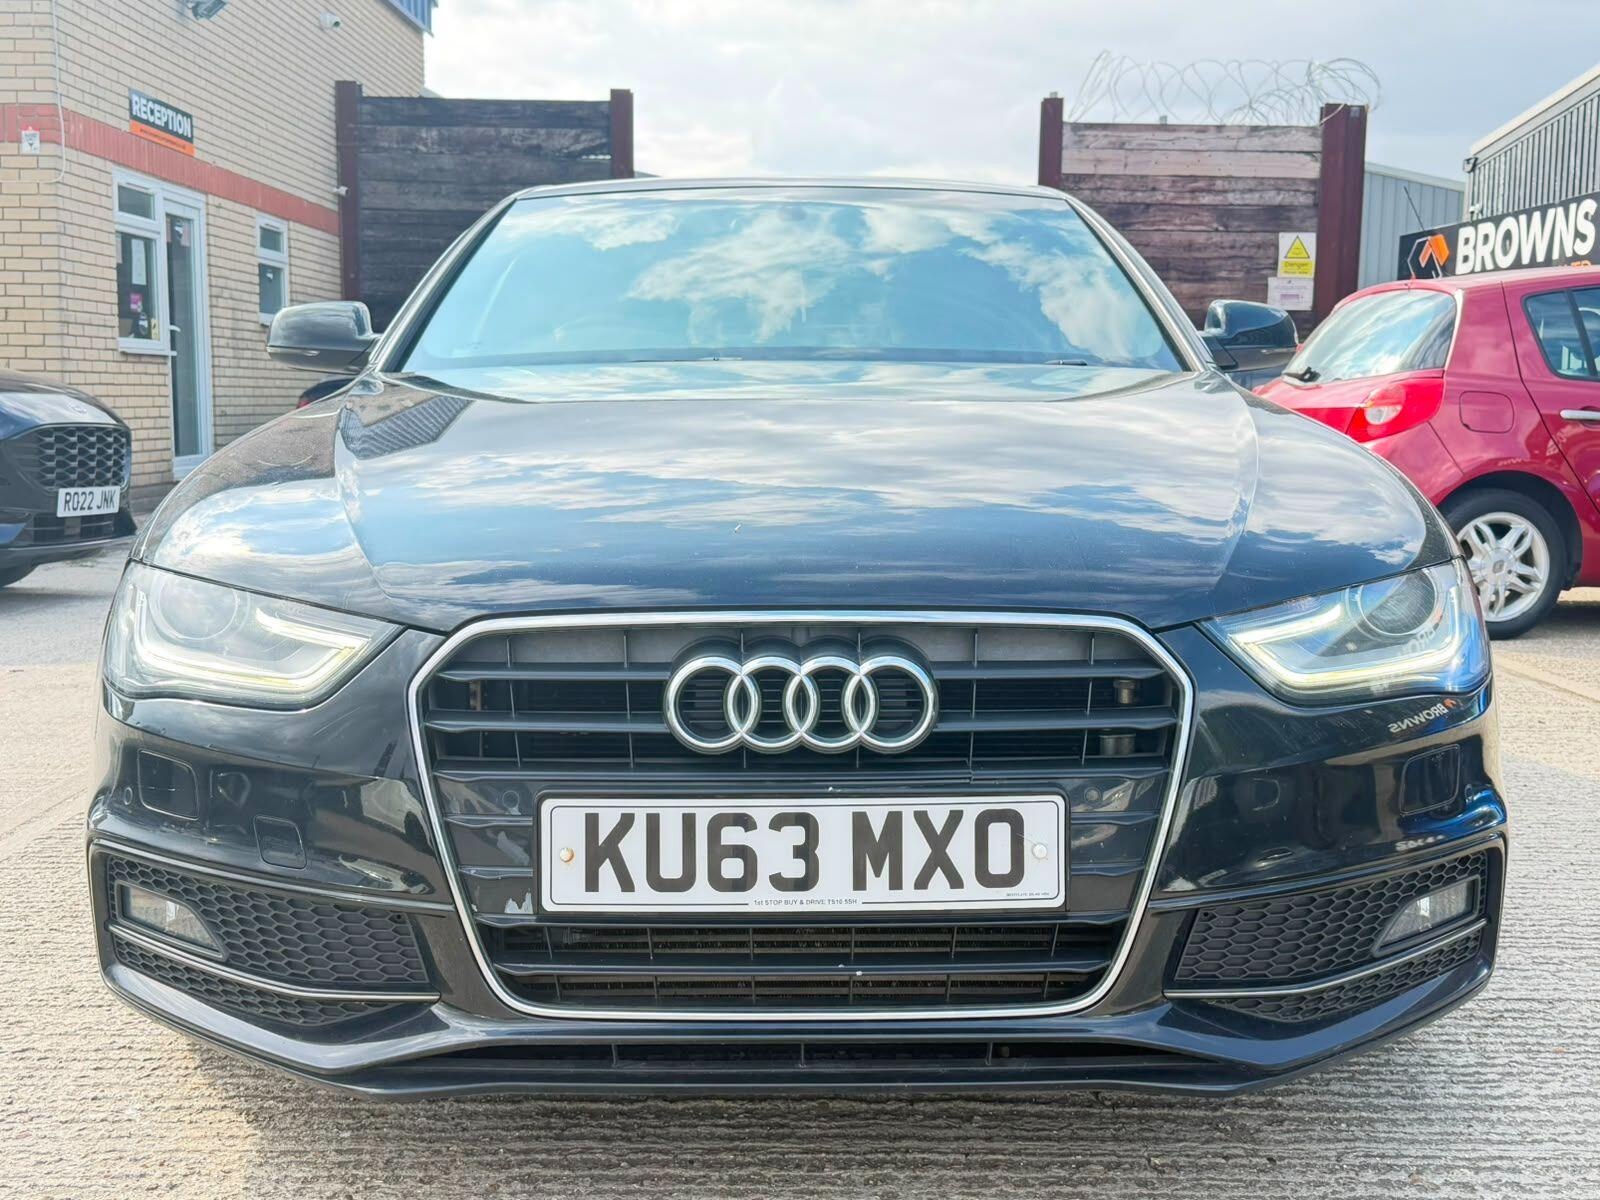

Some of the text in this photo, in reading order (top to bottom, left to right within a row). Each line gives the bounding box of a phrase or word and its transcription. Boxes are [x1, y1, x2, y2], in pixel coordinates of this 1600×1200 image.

[131, 93, 192, 138] RECEPTION
[1455, 198, 1597, 276] BROWNS
[64, 489, 116, 511] RO22 JNK
[584, 808, 1025, 893] KU63 MXO
